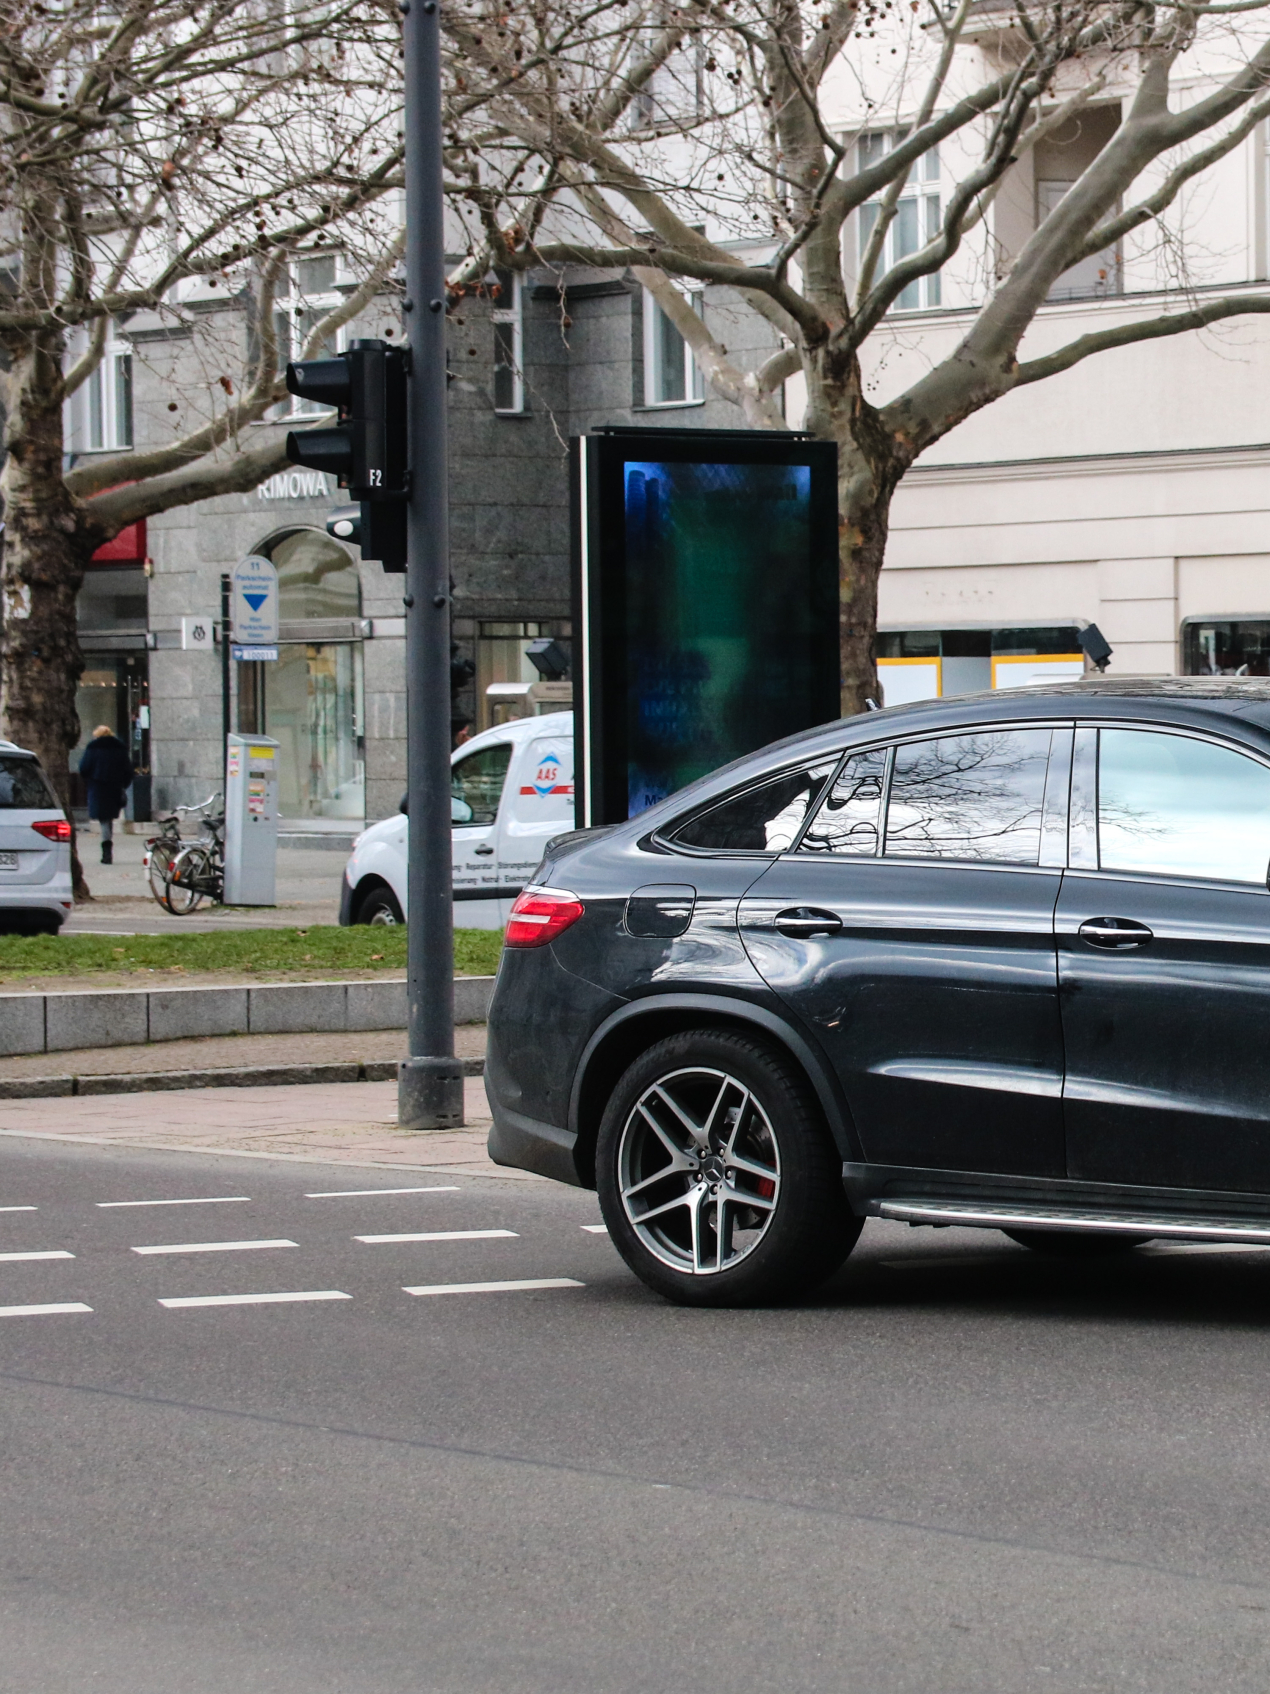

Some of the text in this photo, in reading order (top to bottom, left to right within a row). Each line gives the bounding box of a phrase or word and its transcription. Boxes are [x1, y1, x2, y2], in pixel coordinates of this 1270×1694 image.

[258, 472, 328, 499] RIMOWA
[369, 469, 382, 487] F2
[536, 768, 557, 781] AAS
